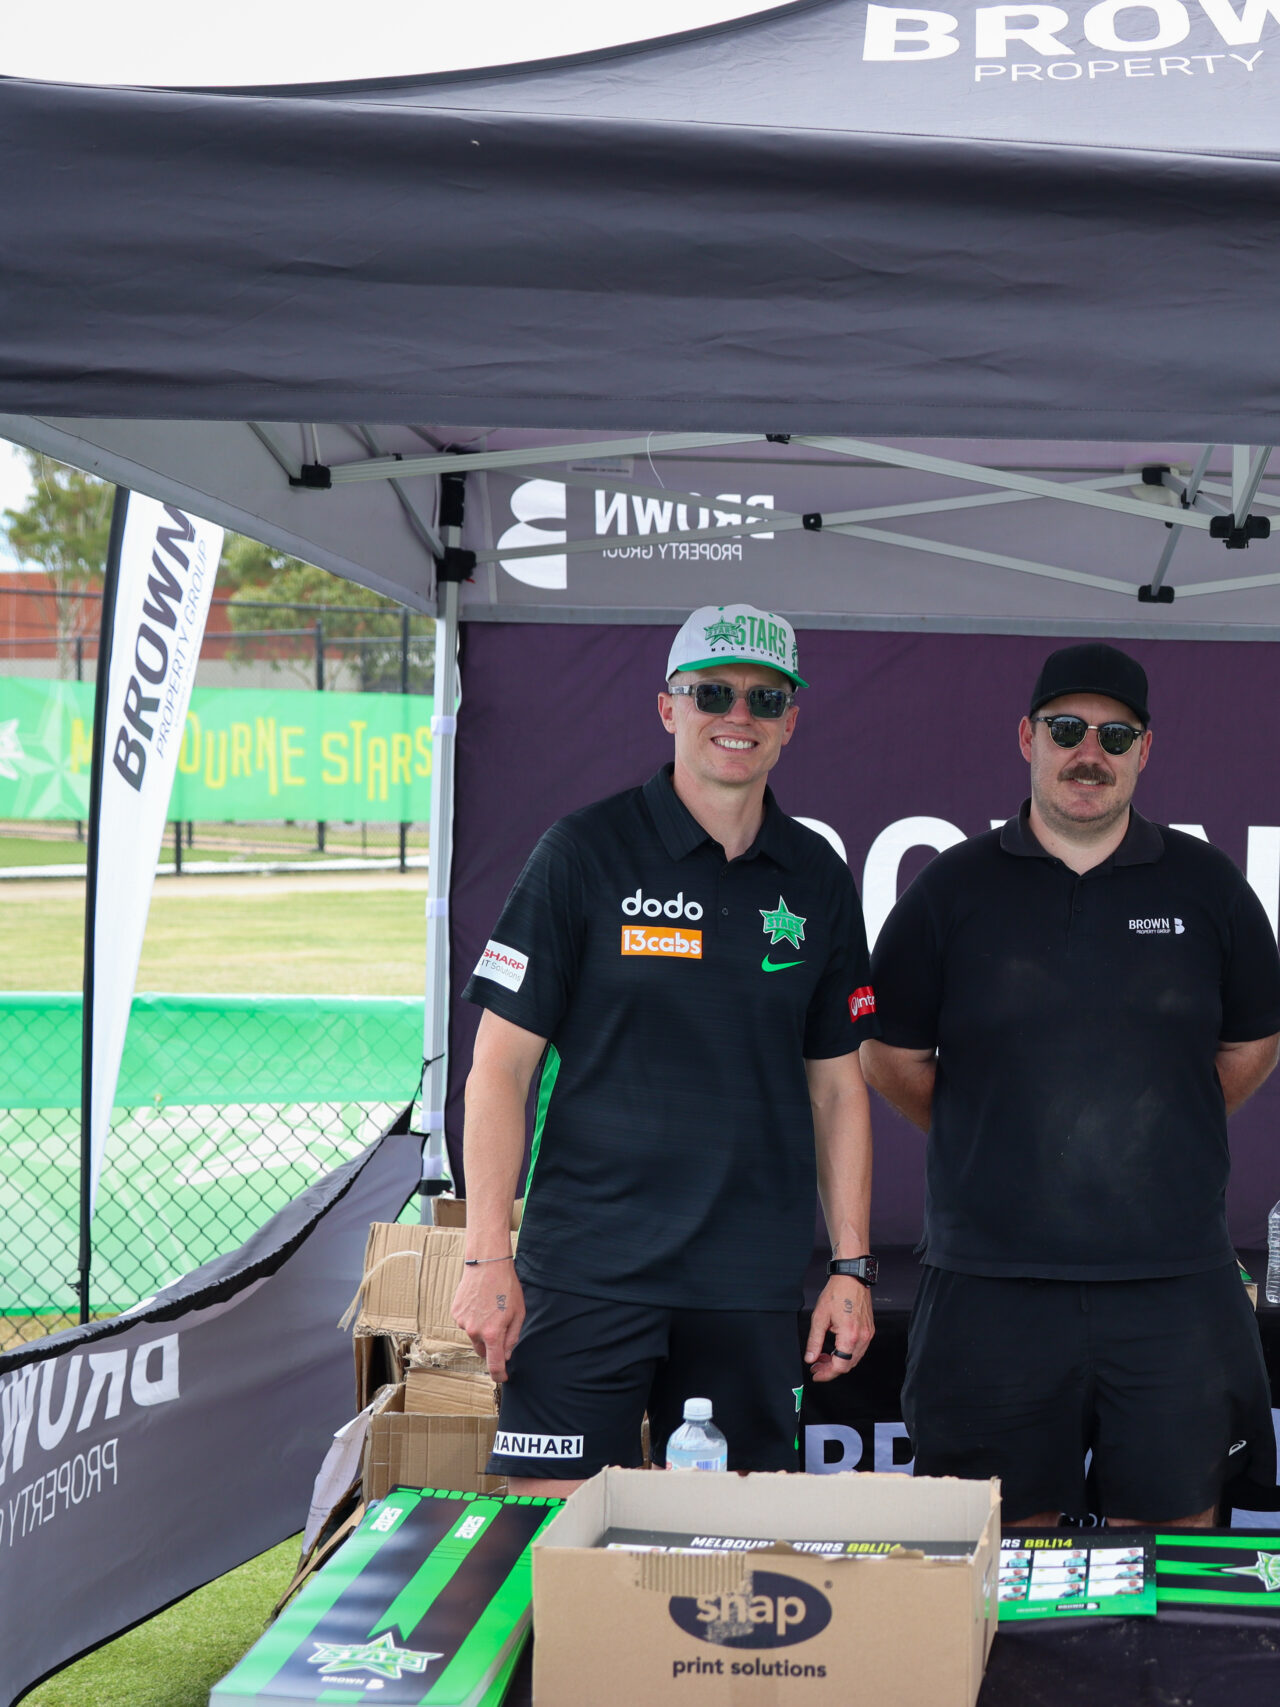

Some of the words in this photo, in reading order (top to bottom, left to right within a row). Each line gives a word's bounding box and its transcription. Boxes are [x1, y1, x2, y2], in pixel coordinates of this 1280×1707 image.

[975, 50, 1264, 82] PROPERTY
[113, 502, 196, 792] BROWN
[156, 627, 190, 760] PROPERTY
[184, 539, 207, 627] GROUP
[735, 615, 787, 658] STARS
[711, 646, 786, 665] MELBOURNE
[321, 720, 433, 802] STARS
[621, 888, 703, 921] dodo
[765, 915, 801, 931] STARS
[1128, 918, 1170, 930] BROWN
[623, 929, 701, 955] 13cabs
[483, 948, 525, 970] SHARP
[491, 961, 521, 982] Solutions
[690, 1536, 775, 1549] MELBOUR
[696, 1594, 807, 1636] snap
[672, 1656, 724, 1678] print
[731, 1657, 827, 1678] solutions
